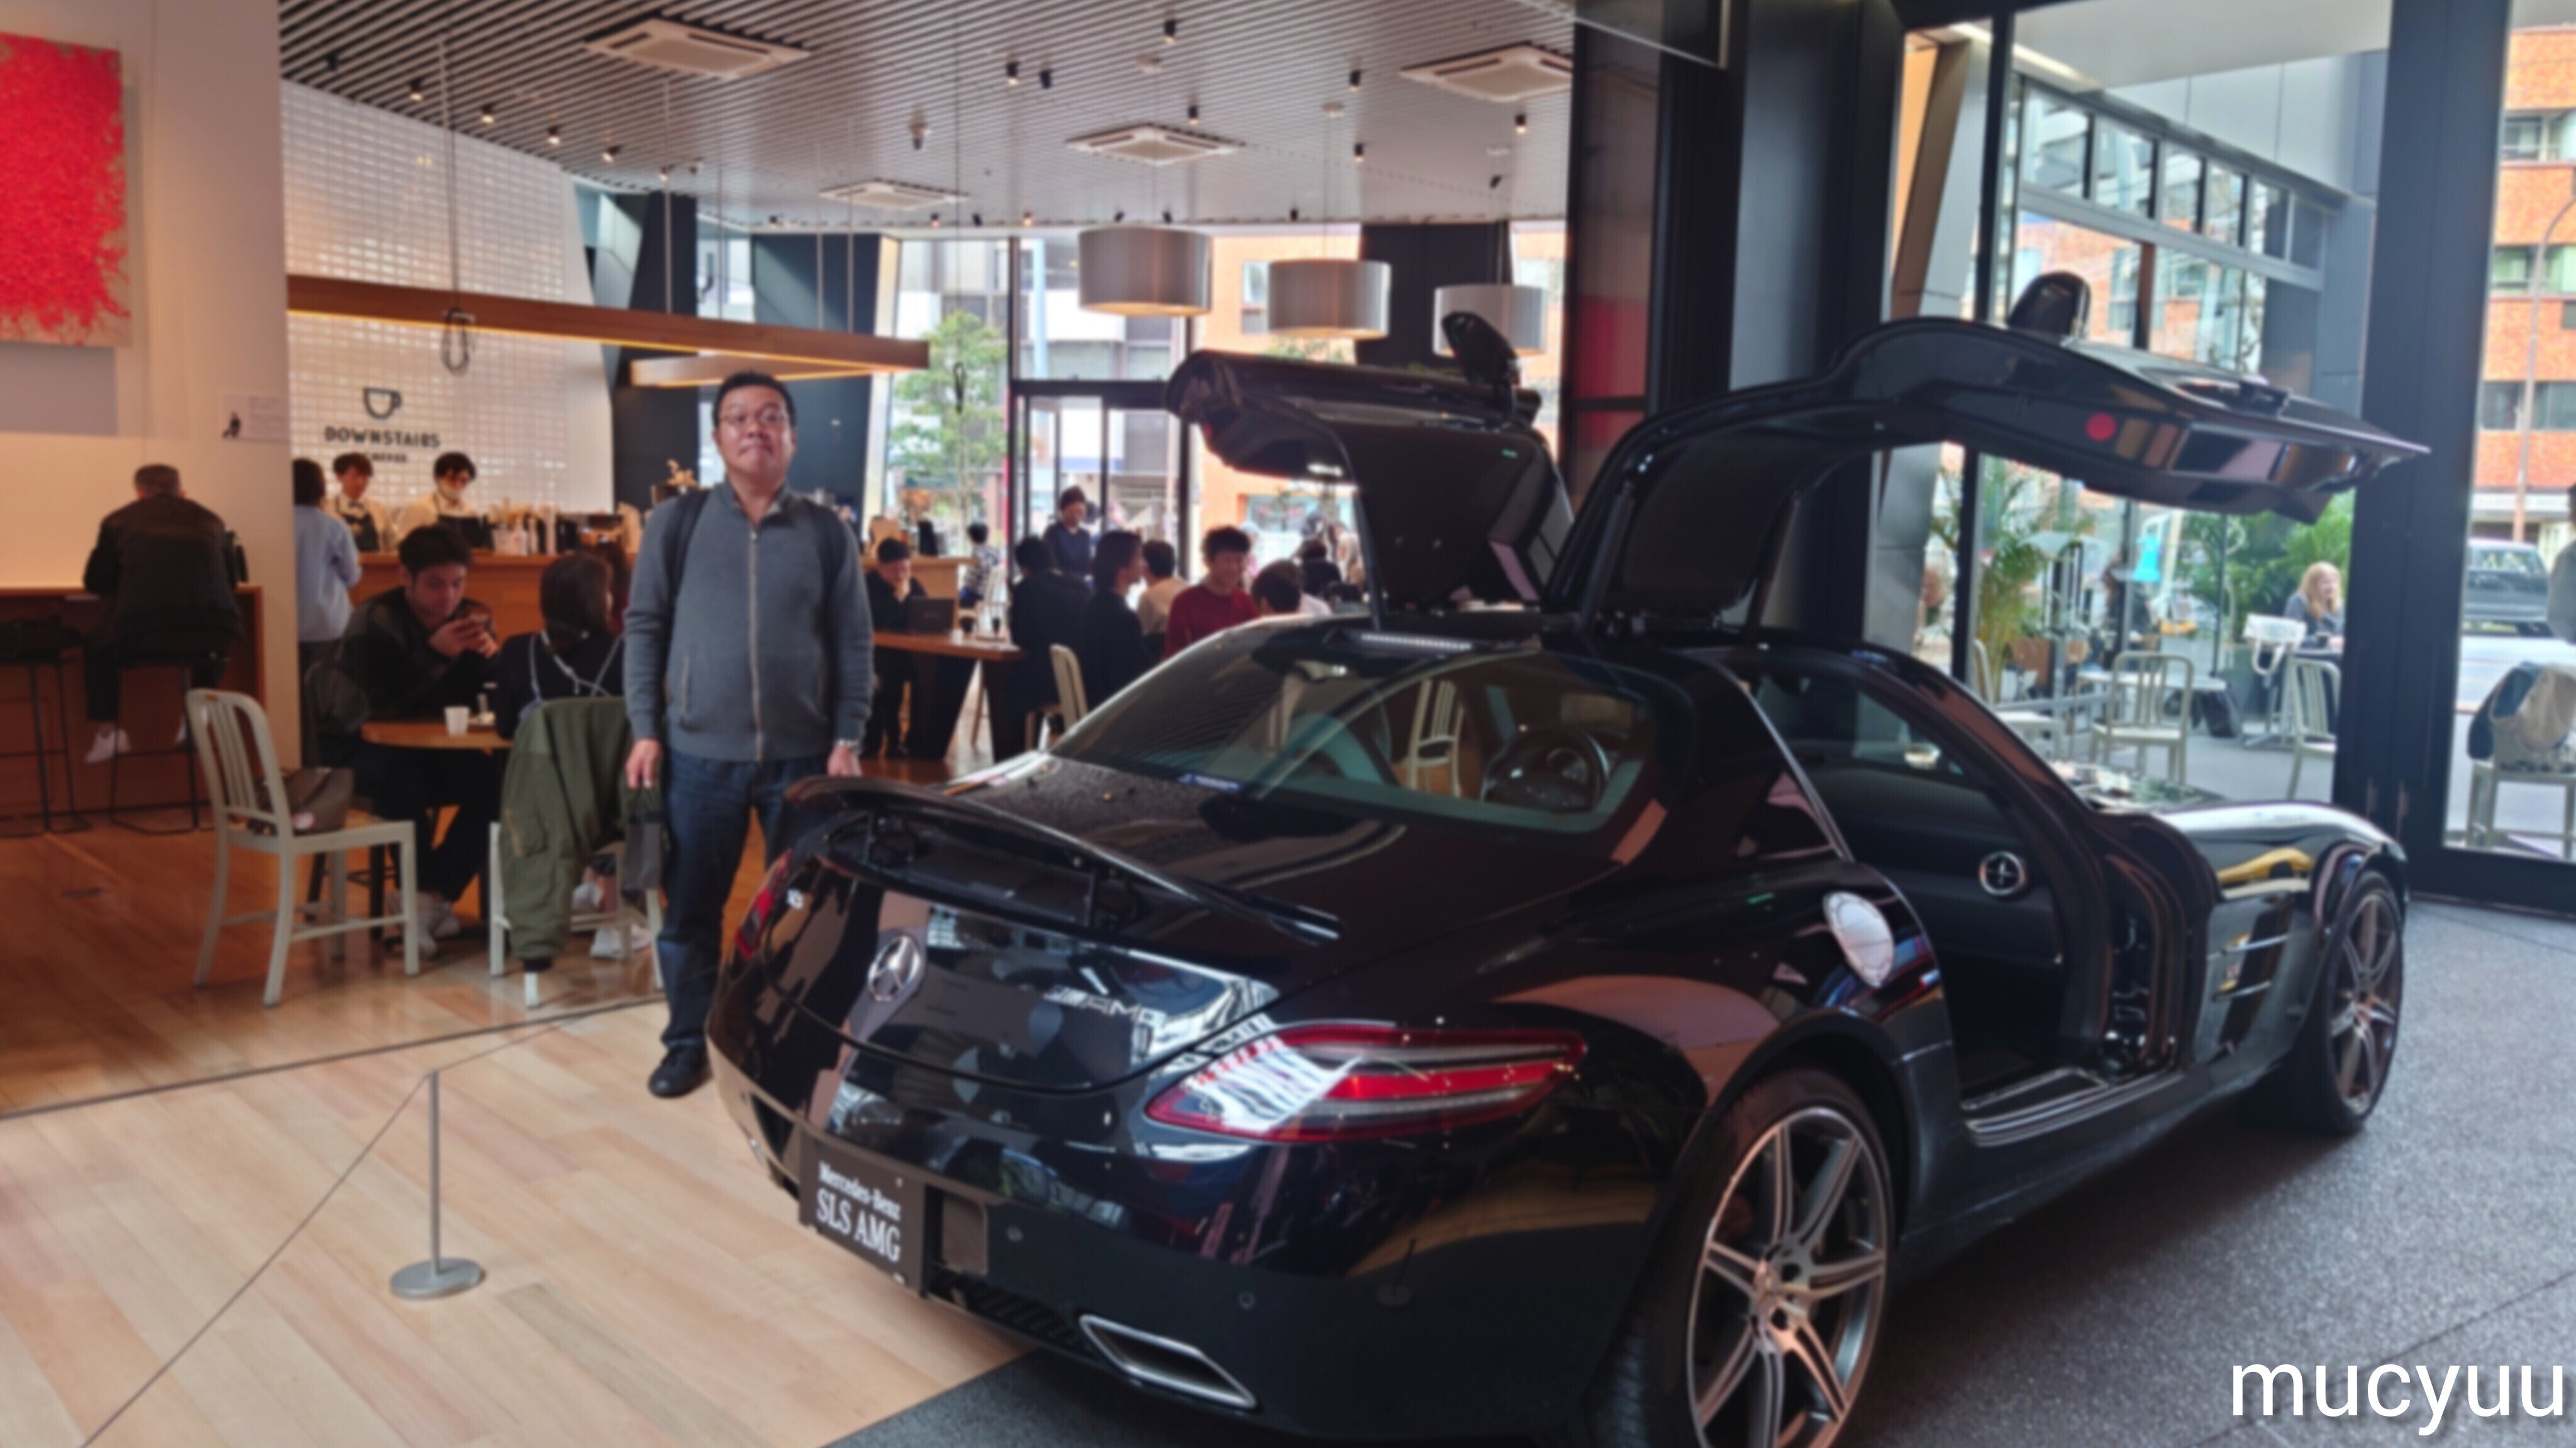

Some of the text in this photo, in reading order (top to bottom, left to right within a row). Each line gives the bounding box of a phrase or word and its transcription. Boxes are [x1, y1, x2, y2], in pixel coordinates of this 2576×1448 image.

[325, 426, 440, 448] DOWNSTAIRS
[819, 1161, 901, 1222] Mercedes-Benz
[817, 1188, 901, 1262] SLS AMG
